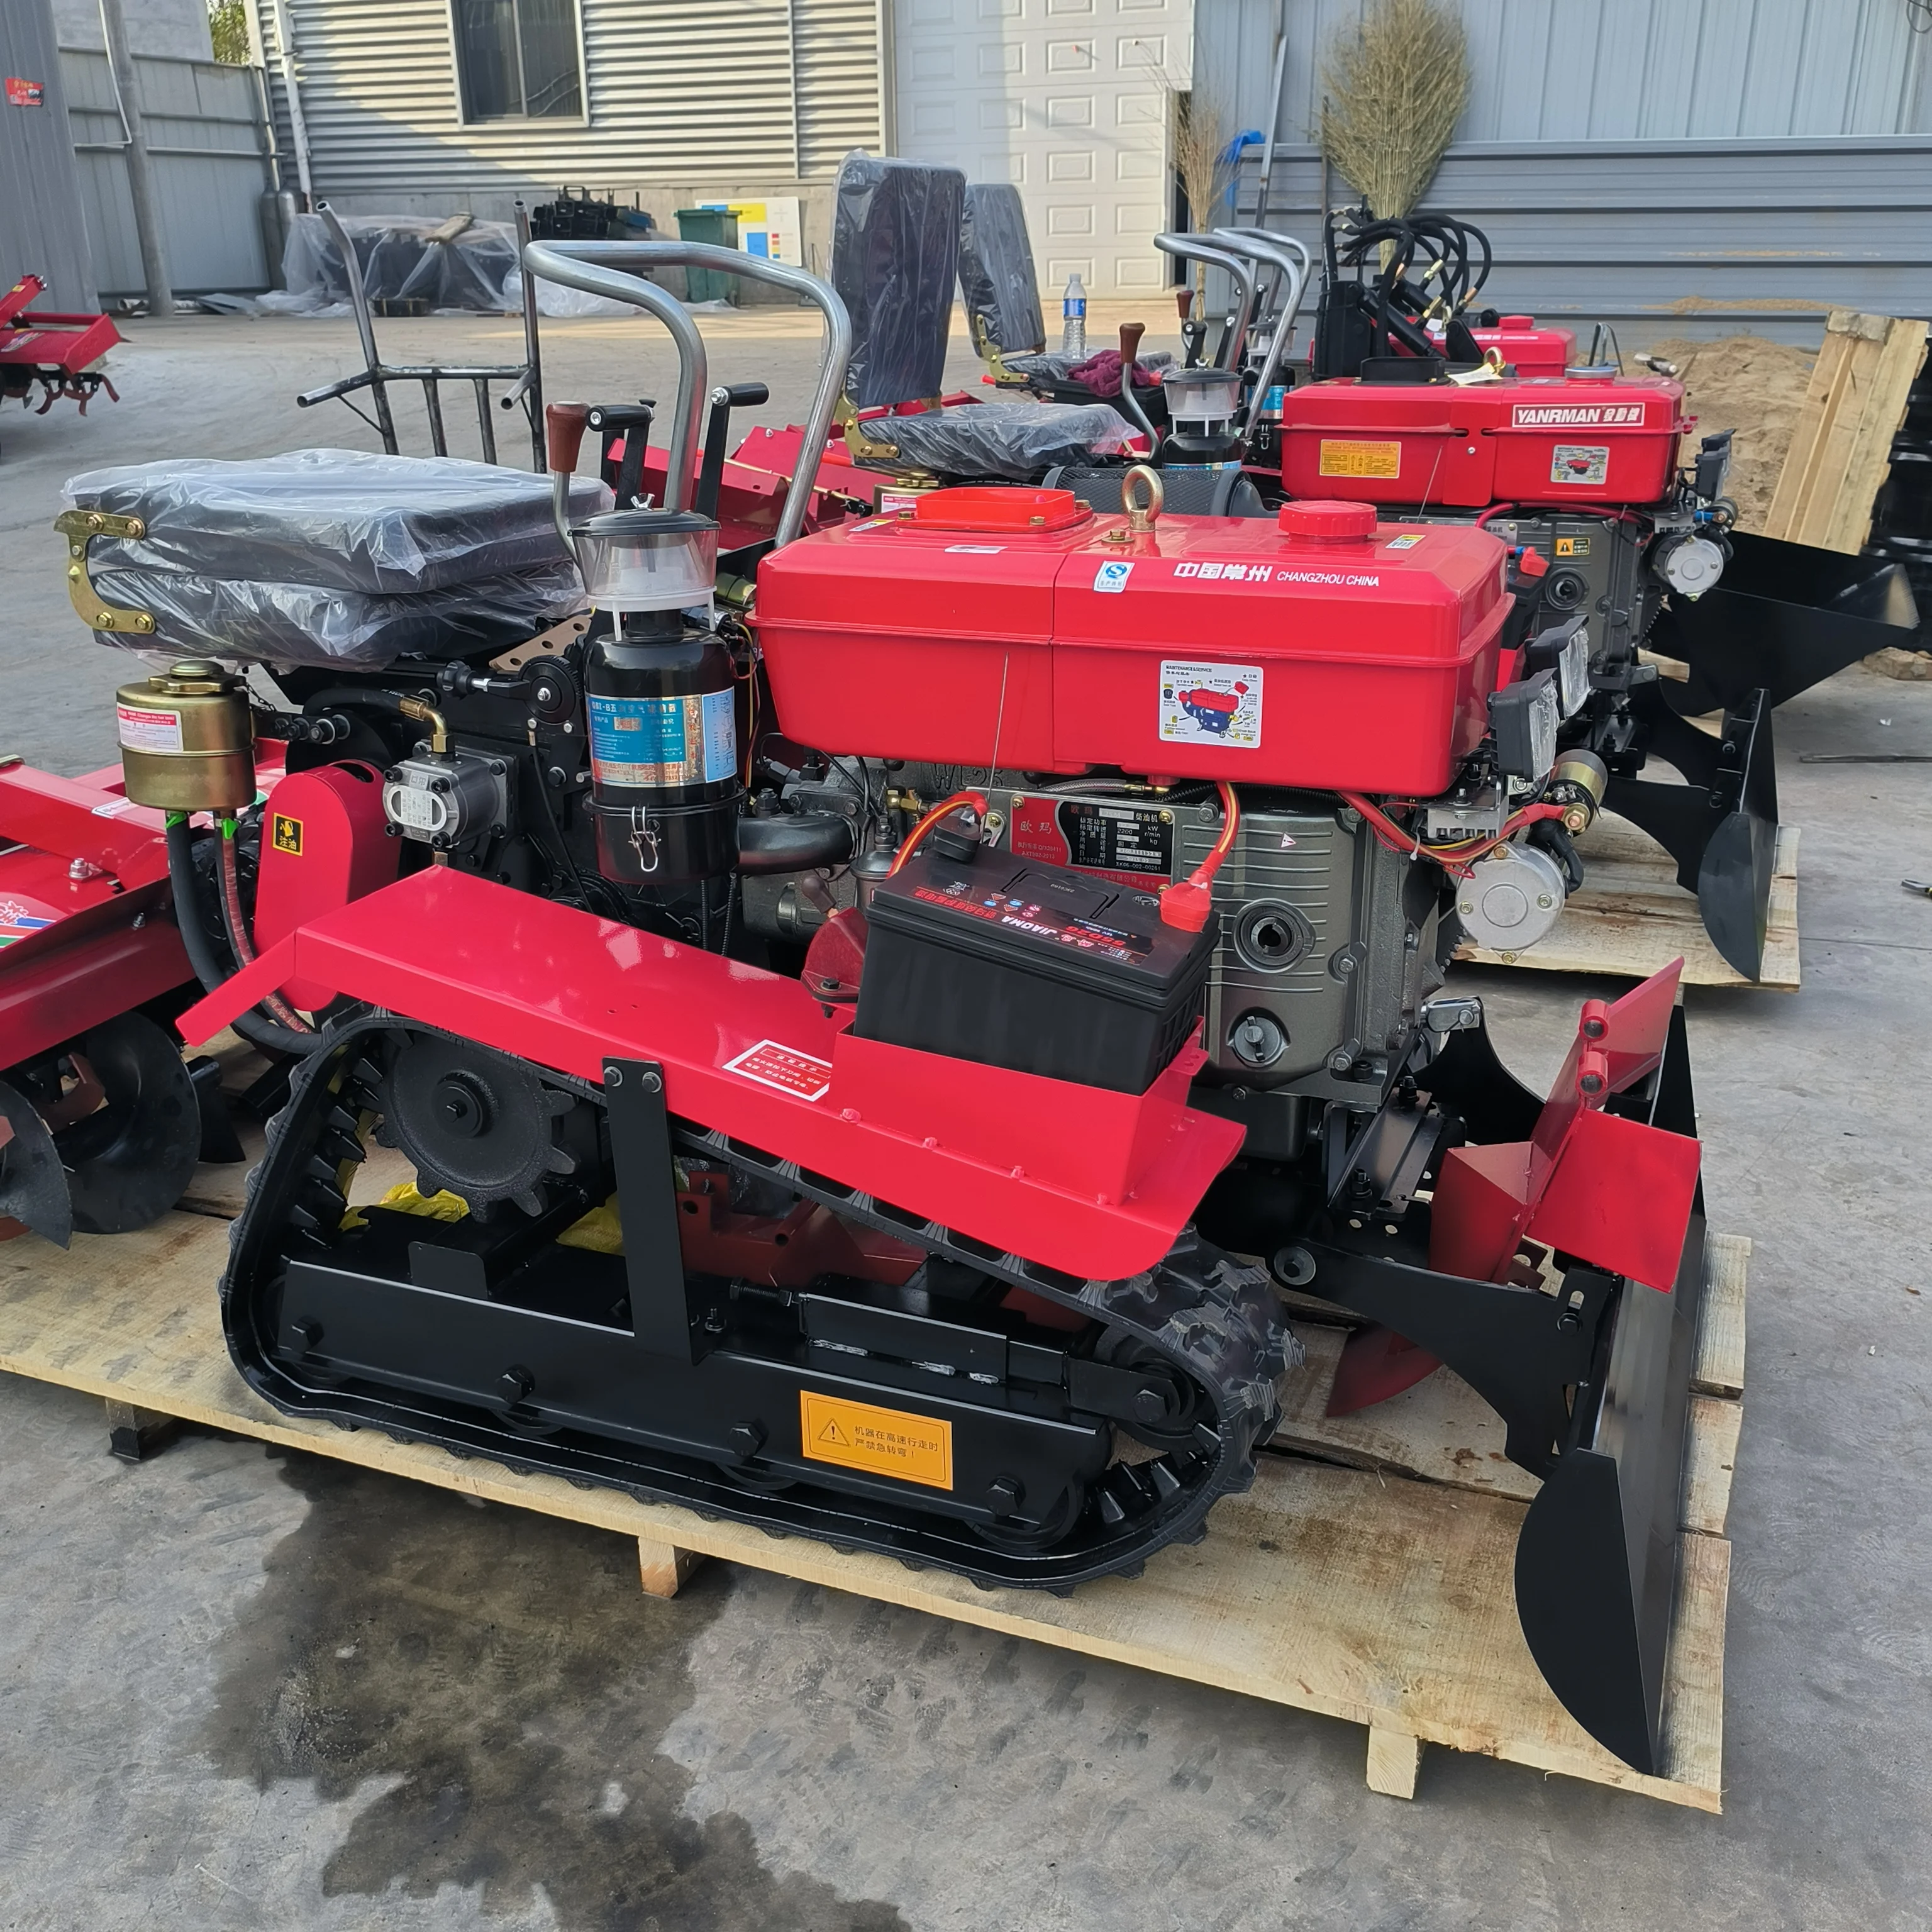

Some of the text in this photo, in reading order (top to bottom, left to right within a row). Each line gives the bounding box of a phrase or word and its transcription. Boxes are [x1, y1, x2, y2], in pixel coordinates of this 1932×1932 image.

[1518, 409, 1601, 423] YANRMAN
[1174, 562, 1272, 582] 中国常州
[1277, 570, 1380, 587] CHANGZHOU CHINA
[1135, 812, 1158, 823] 柴油机
[1019, 820, 1052, 834] 欧玛
[279, 835, 297, 851] 注油
[1001, 914, 1058, 936] JIAOMA
[855, 1425, 938, 1452] 机器在高速行走时
